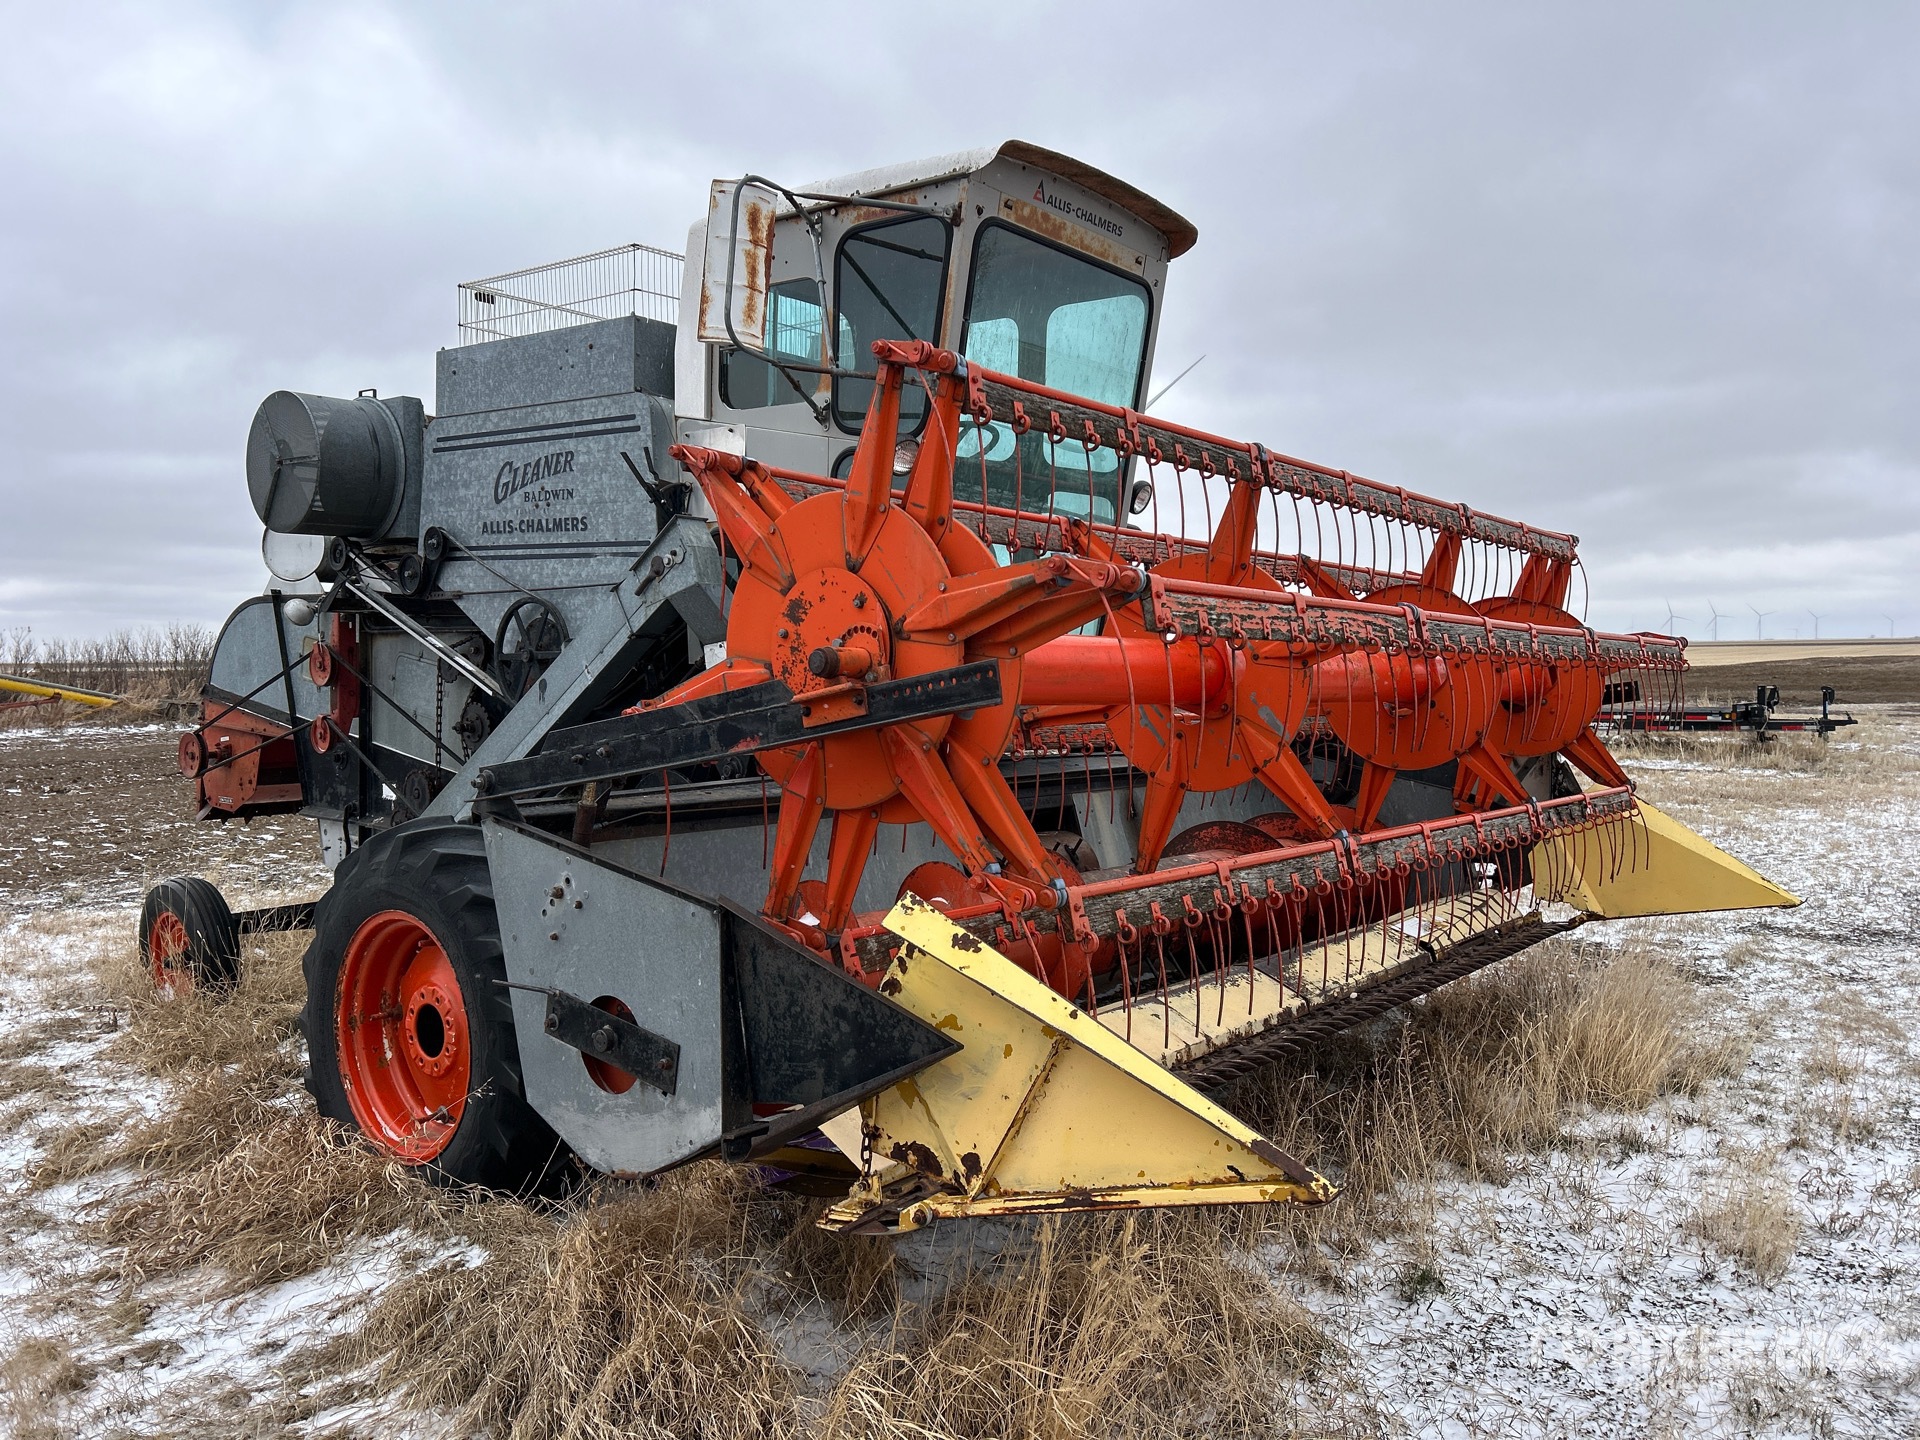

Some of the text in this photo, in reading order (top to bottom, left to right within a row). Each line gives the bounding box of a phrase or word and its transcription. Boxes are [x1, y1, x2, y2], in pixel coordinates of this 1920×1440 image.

[1046, 194, 1124, 237] ALLIS-CHALMERS
[494, 450, 575, 504] GLEANER
[523, 488, 574, 503] BALDWIN
[481, 516, 589, 535] ALLIS-CHALMERS
